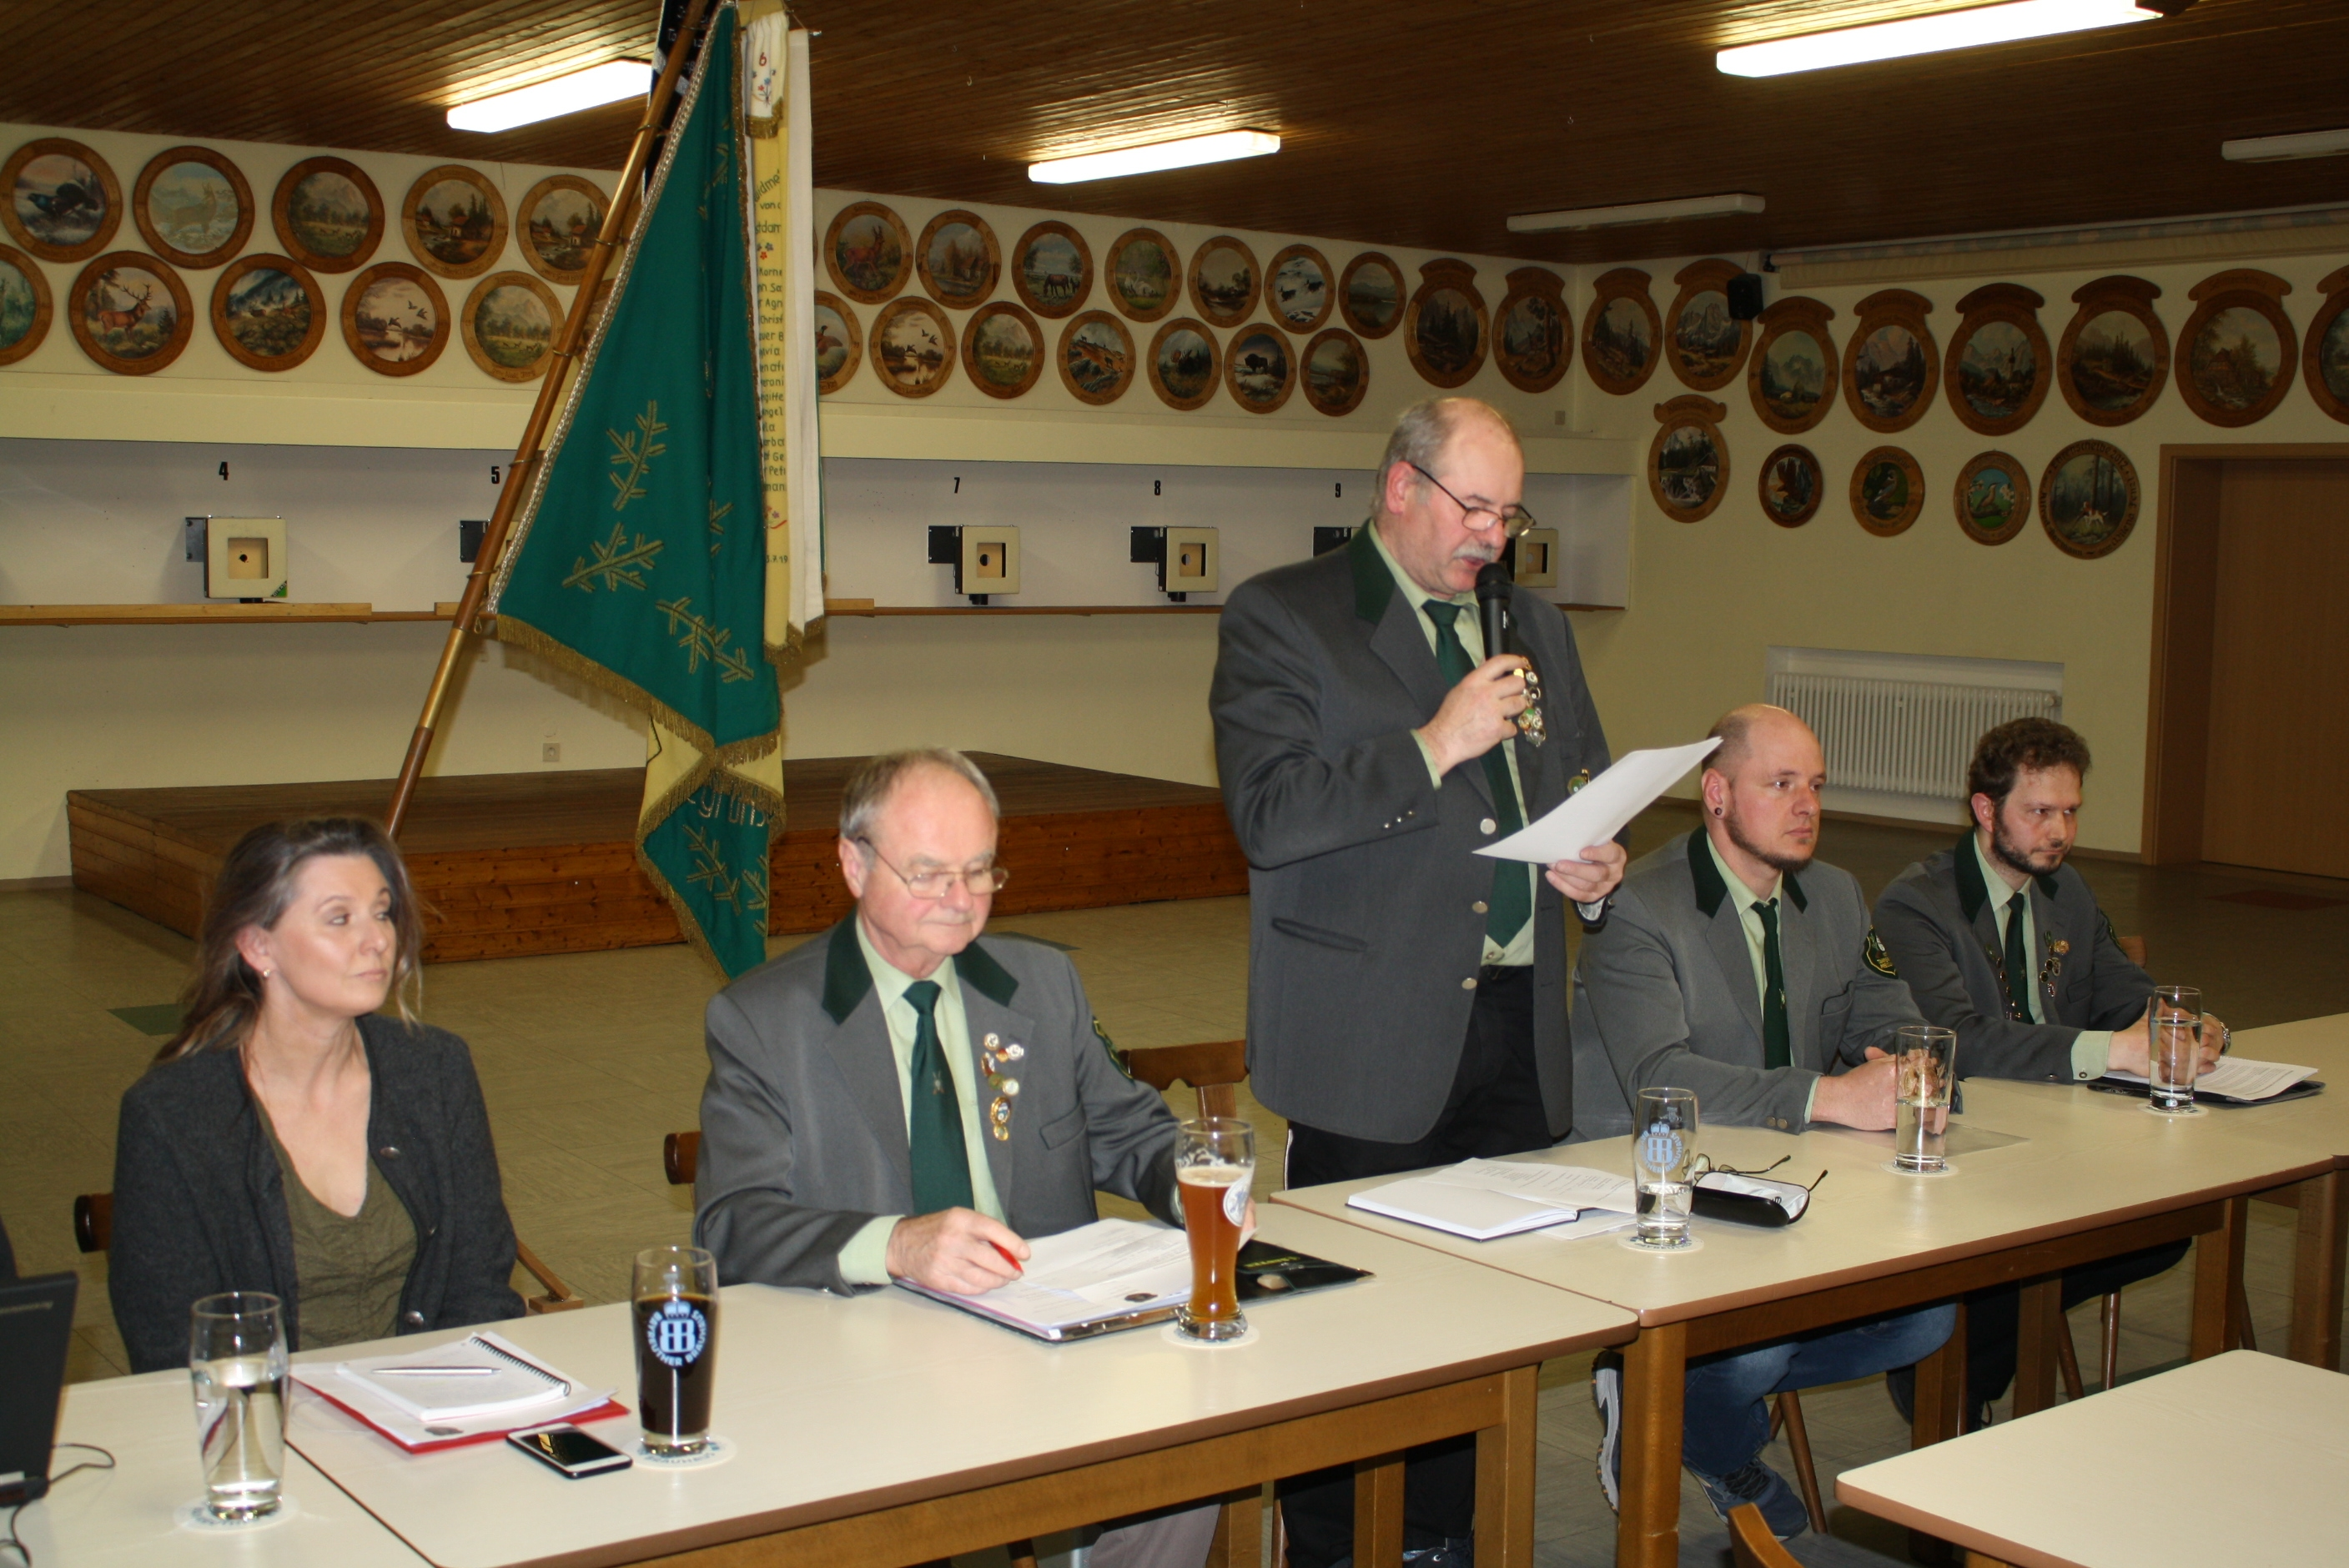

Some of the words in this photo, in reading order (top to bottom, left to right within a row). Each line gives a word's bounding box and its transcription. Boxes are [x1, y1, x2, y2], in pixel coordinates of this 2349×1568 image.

[758, 52, 767, 67] 6
[2110, 450, 2128, 471] 2012
[219, 461, 229, 481] 4
[491, 466, 500, 485] 5
[953, 476, 961, 495] 7
[1154, 480, 1161, 496] 8
[1335, 483, 1341, 498] 9
[1665, 1132, 1683, 1172] BRAUHAUS
[647, 1311, 683, 1367] BAYREUTHER
[685, 1309, 707, 1364] BRAUHAUS
